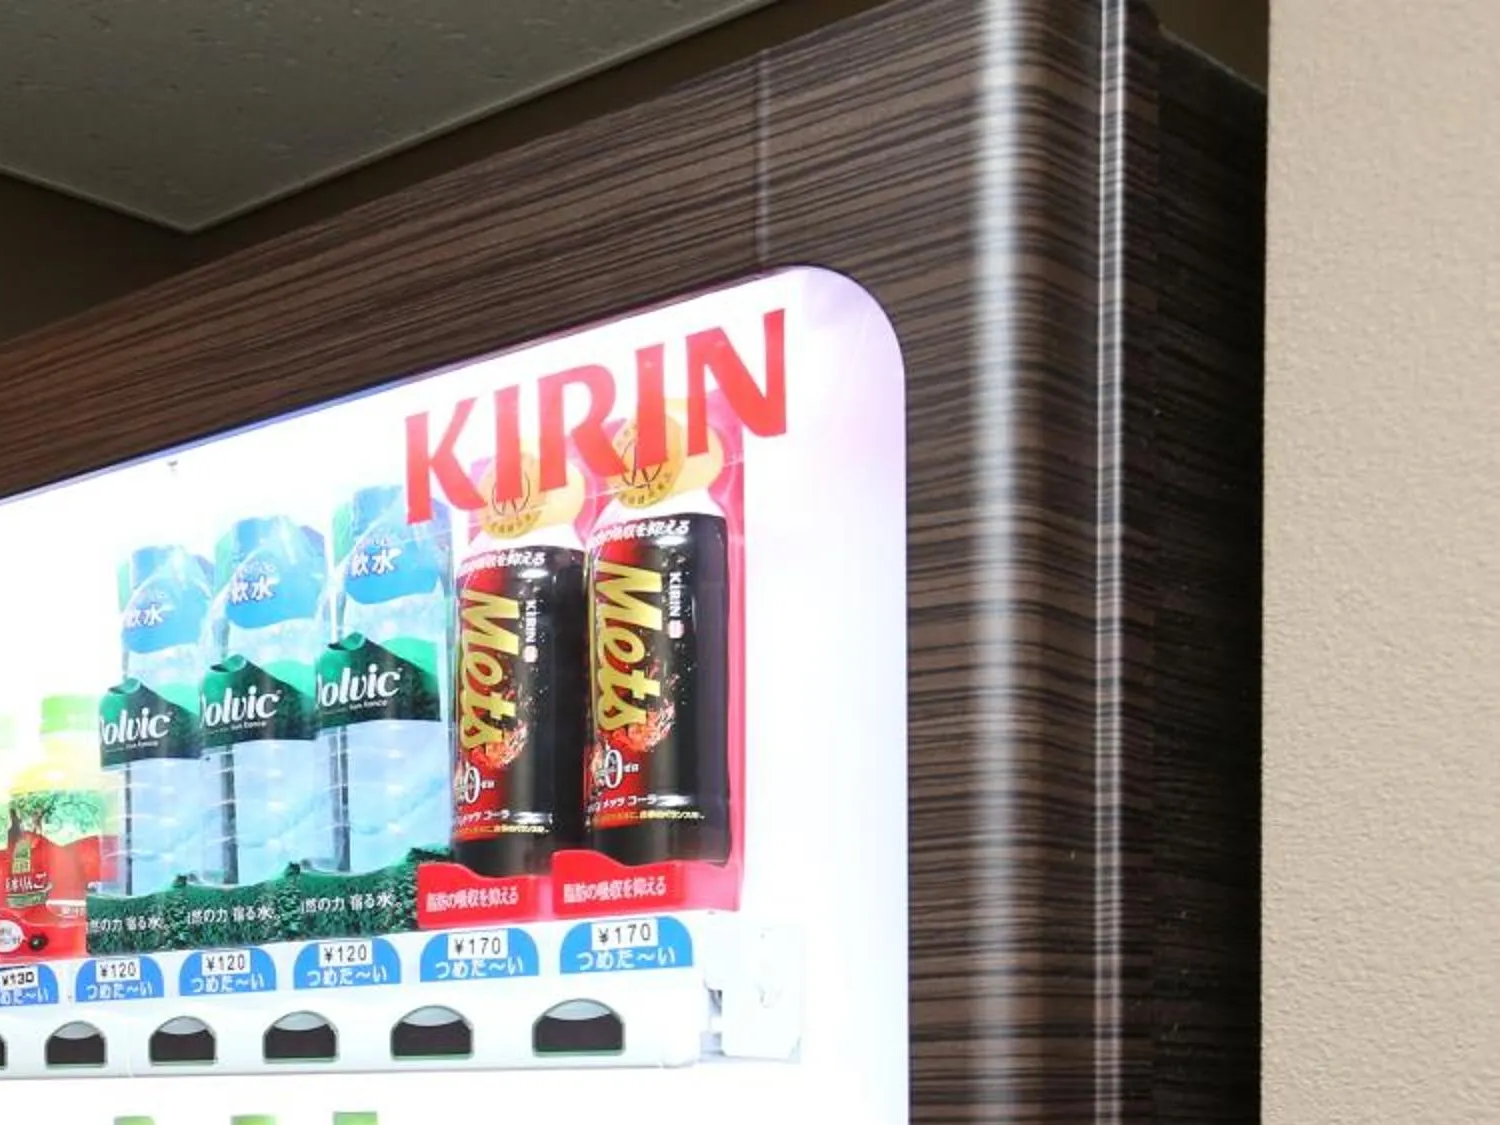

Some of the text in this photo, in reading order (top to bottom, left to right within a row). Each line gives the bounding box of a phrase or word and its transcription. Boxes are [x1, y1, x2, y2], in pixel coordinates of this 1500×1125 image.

[405, 308, 787, 525] KIRIN
[668, 571, 683, 618] KIRIN
[524, 600, 538, 646] KIRIN
[595, 559, 664, 731] Mets
[458, 588, 521, 750] Mets
[100, 707, 172, 746] olvic
[563, 875, 668, 904] 脂肪の吸収を抑える
[301, 897, 346, 913] 然の力
[188, 909, 228, 925] 然の力
[598, 923, 651, 945] ¥170
[323, 944, 368, 963] ¥120
[454, 936, 502, 956] ¥170
[101, 963, 137, 979] ¥120
[206, 953, 246, 971] ¥120
[1, 971, 35, 988] ¥130
